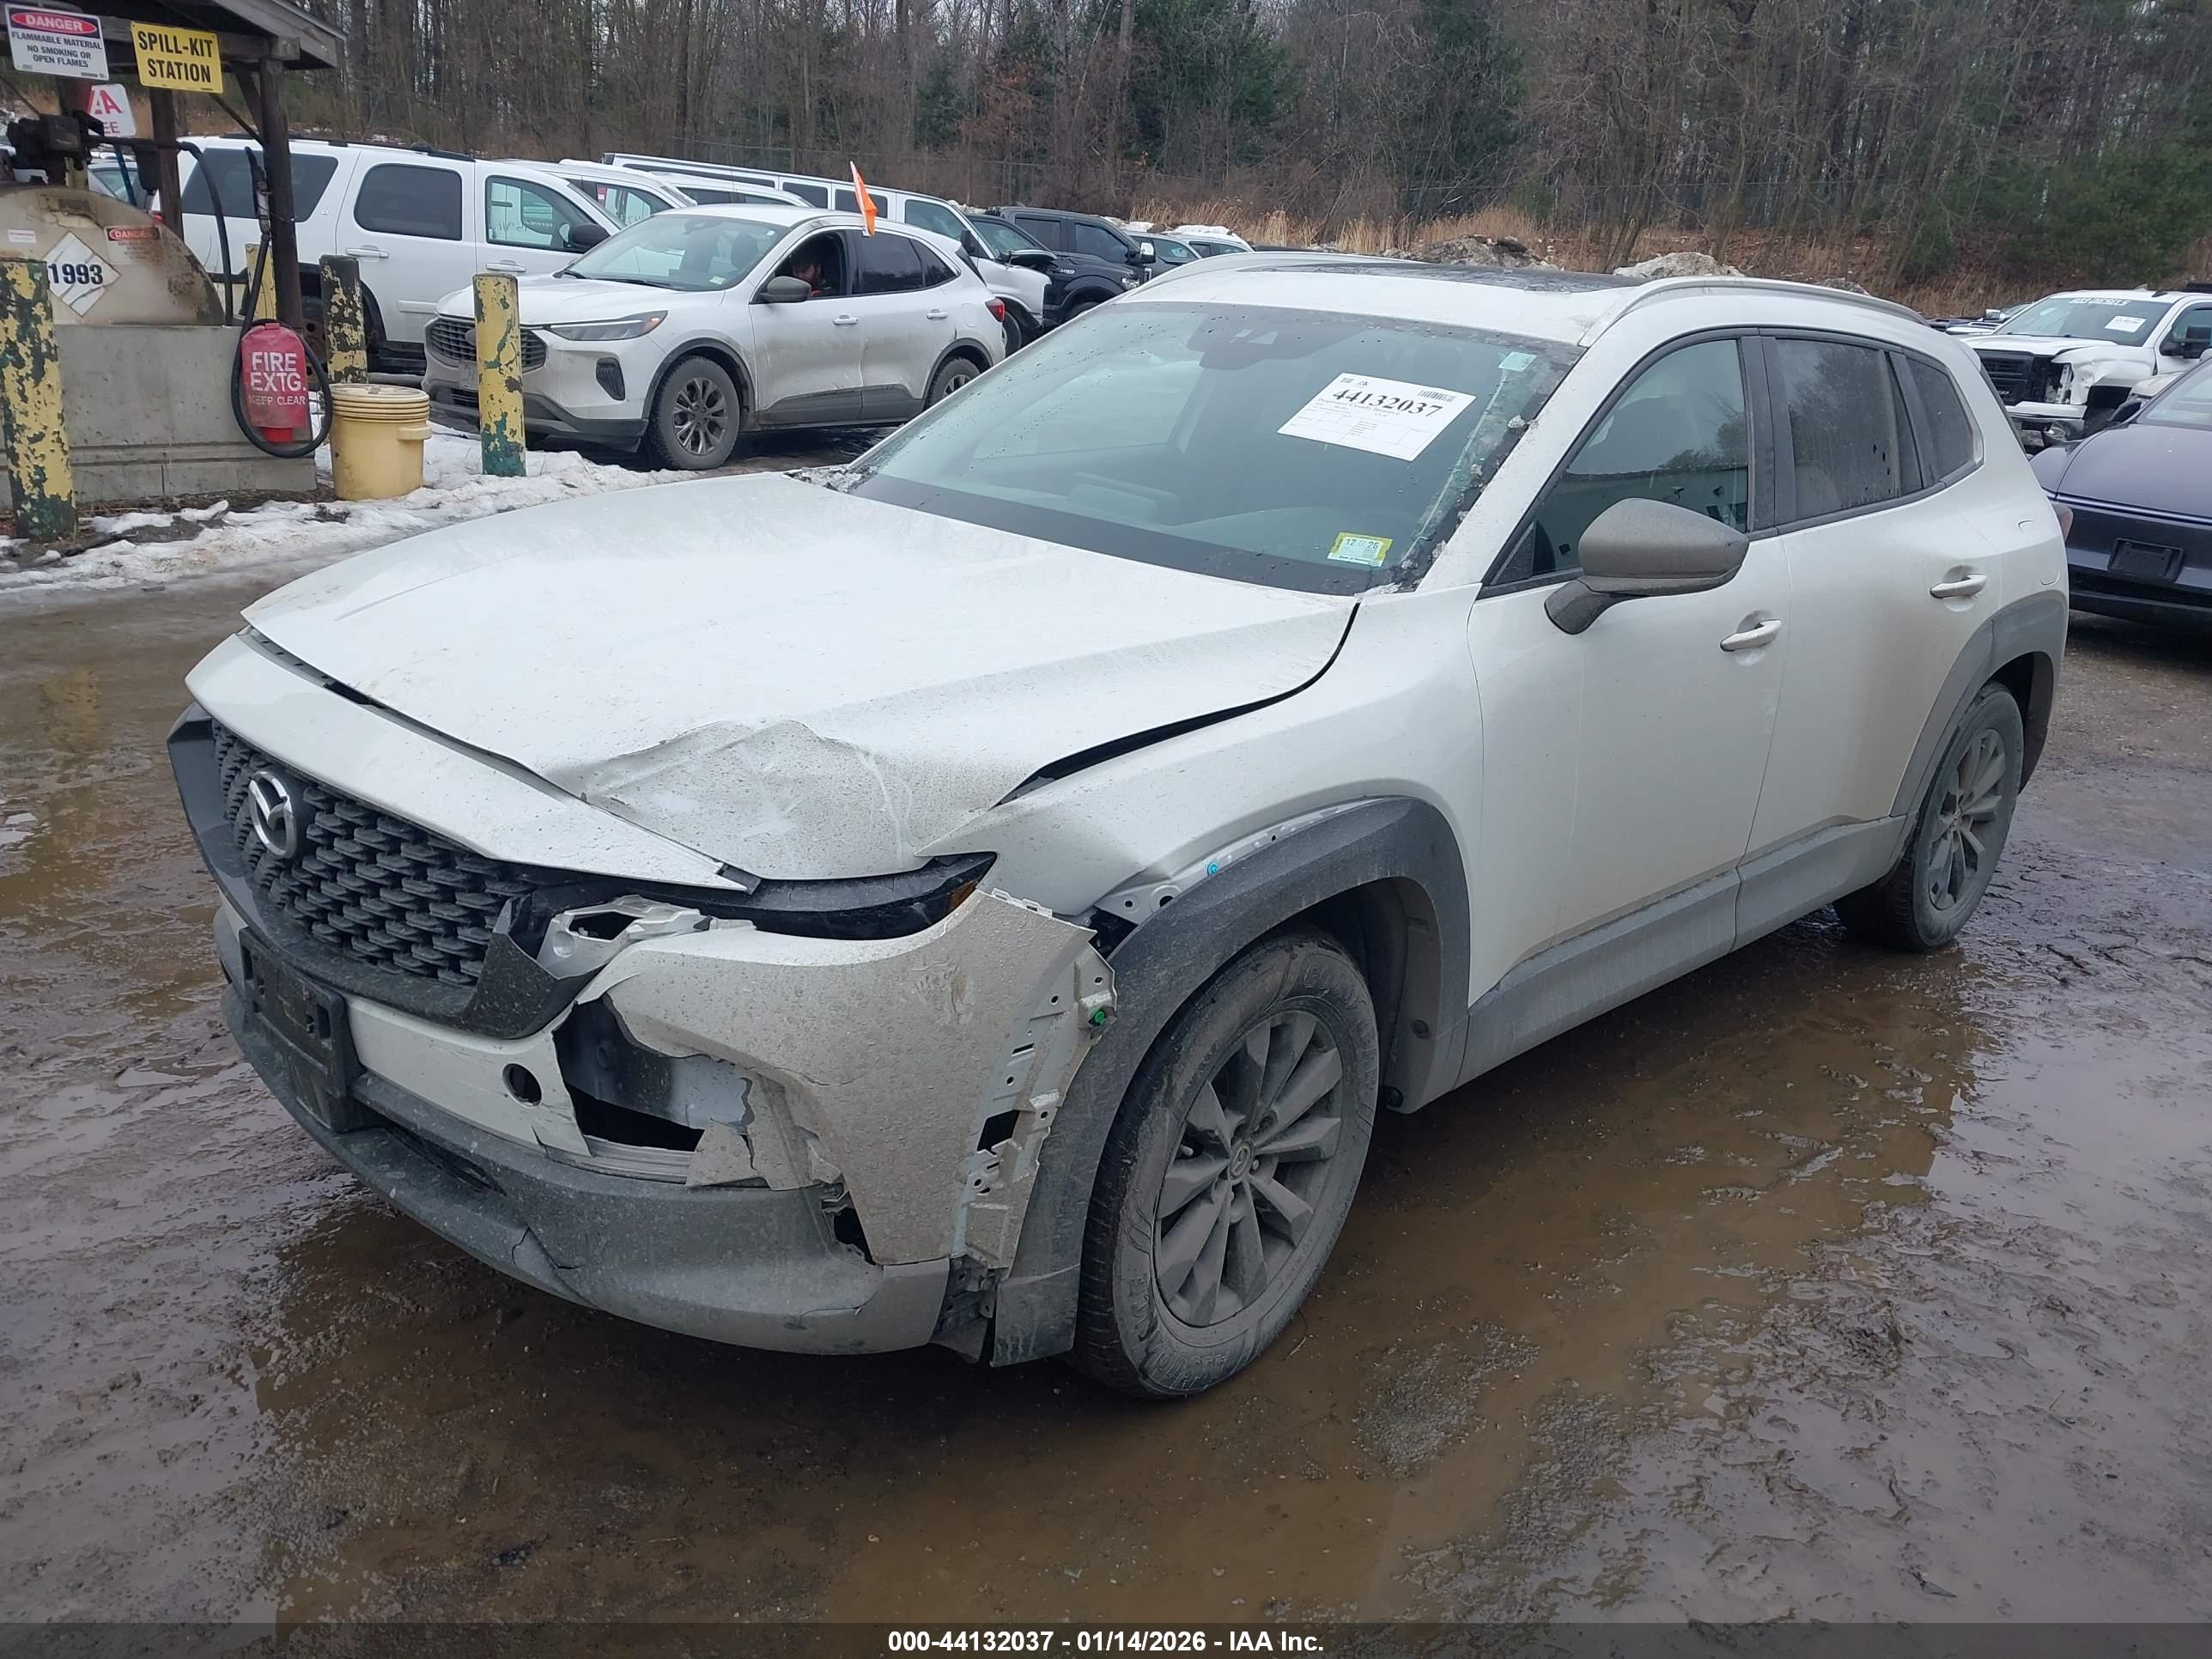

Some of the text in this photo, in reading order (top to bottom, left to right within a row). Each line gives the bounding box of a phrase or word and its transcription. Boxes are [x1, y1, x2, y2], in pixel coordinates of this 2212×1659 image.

[25, 15, 83, 32] DANGER
[11, 31, 102, 50] FLAMMABLE MATERIAL
[137, 31, 213, 58] SPILL-KIT
[33, 54, 88, 68] OPEN FLAMES
[41, 46, 78, 58] SMOKING
[147, 58, 211, 83] STATION
[48, 263, 103, 285] 1993
[252, 351, 297, 372] FIRE
[250, 372, 307, 392] EXTG.
[248, 394, 306, 405] KEEP CLEAR
[1333, 389, 1443, 417] 44132037
[1346, 538, 1357, 547] 12
[1367, 541, 1380, 550] 26
